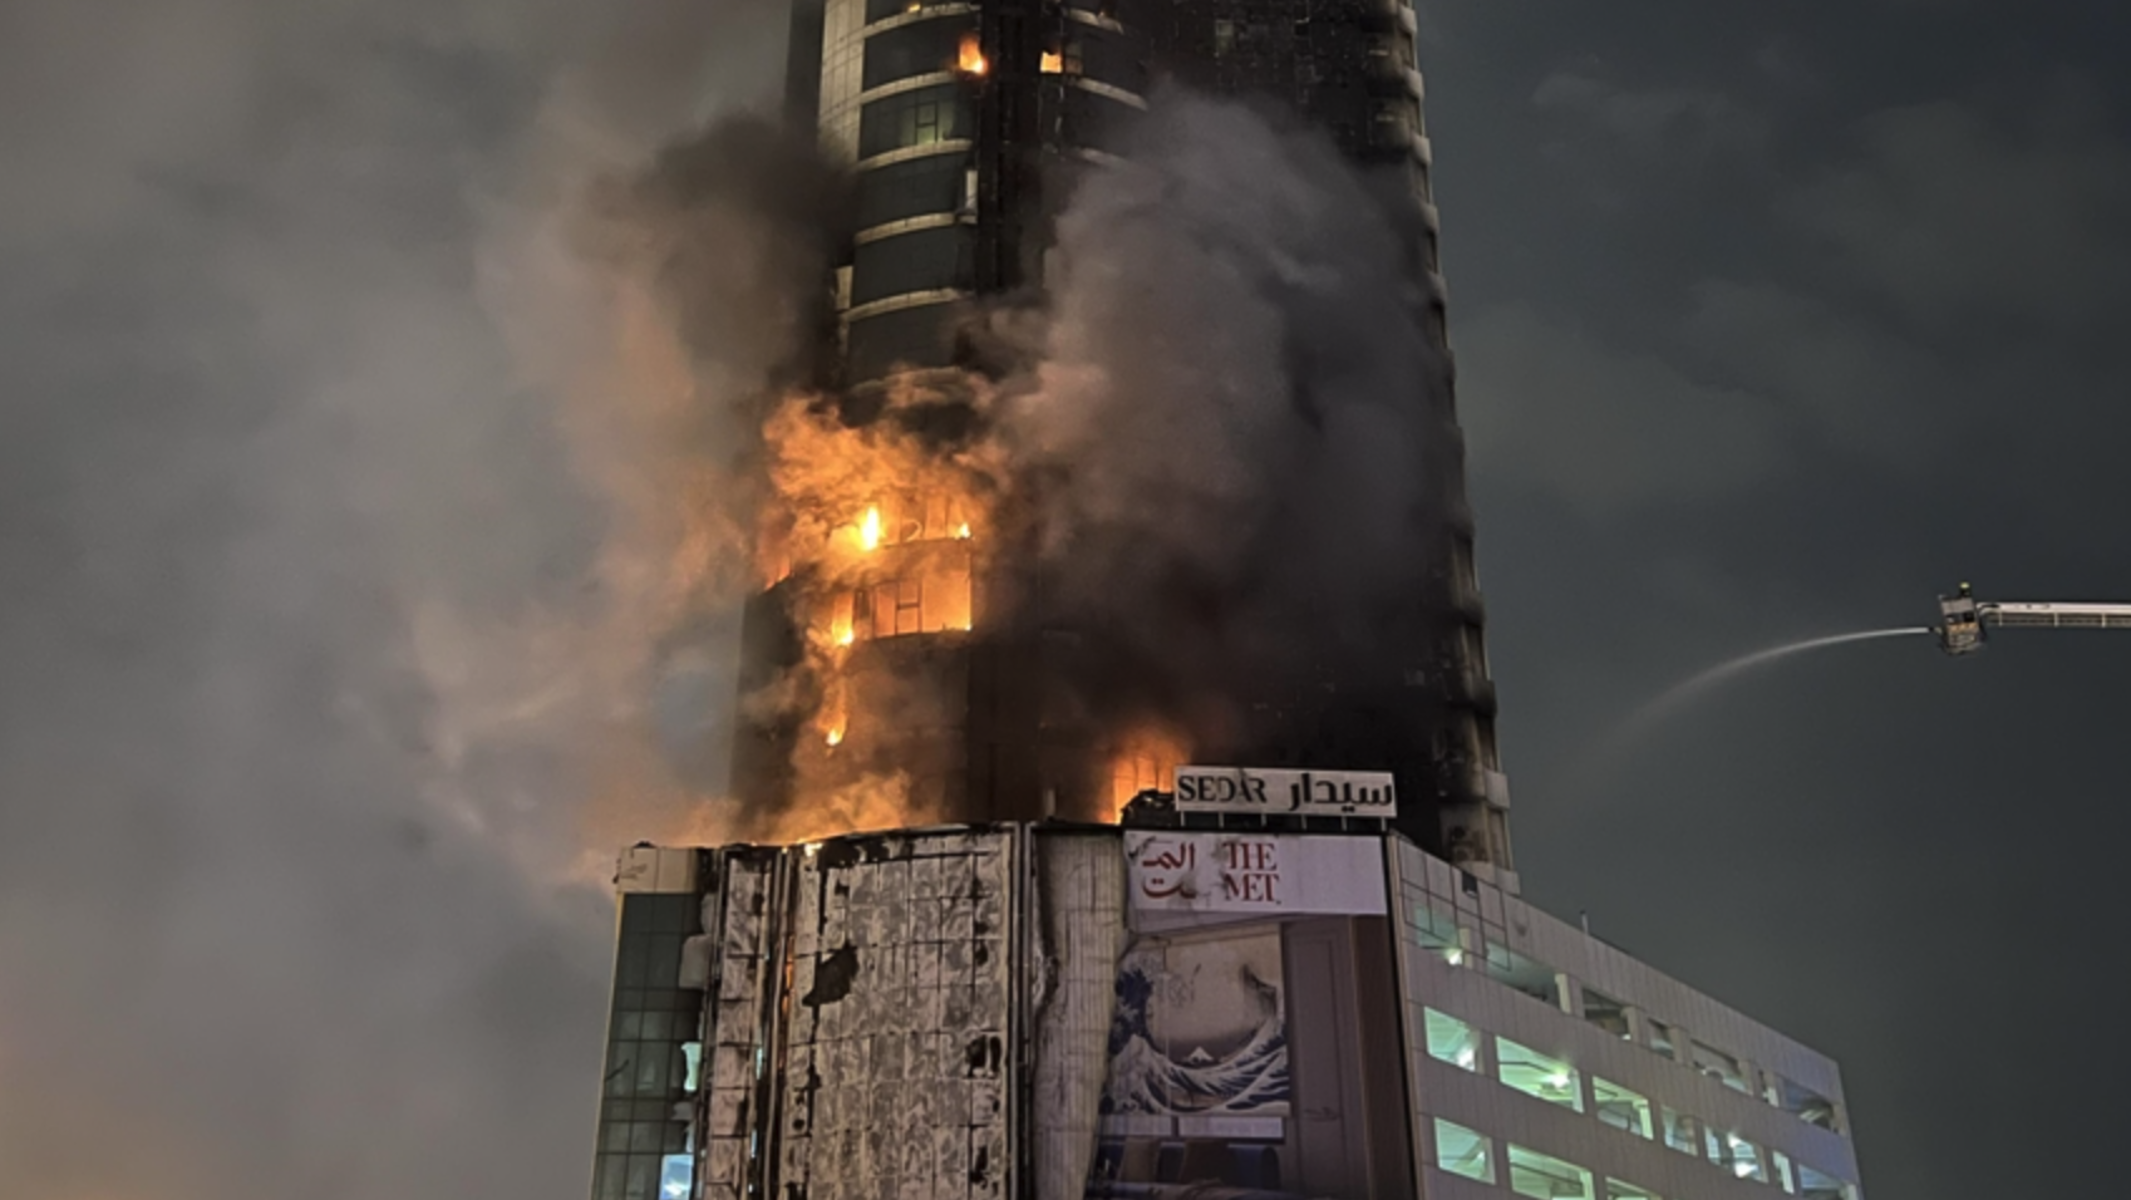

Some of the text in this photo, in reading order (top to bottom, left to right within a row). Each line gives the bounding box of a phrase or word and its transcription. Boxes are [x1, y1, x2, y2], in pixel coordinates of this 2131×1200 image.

[1178, 775, 1267, 803] SEDAR
[1289, 772, 1392, 813] سيدار
[1222, 842, 1277, 870] THE
[1223, 872, 1279, 902] MET
